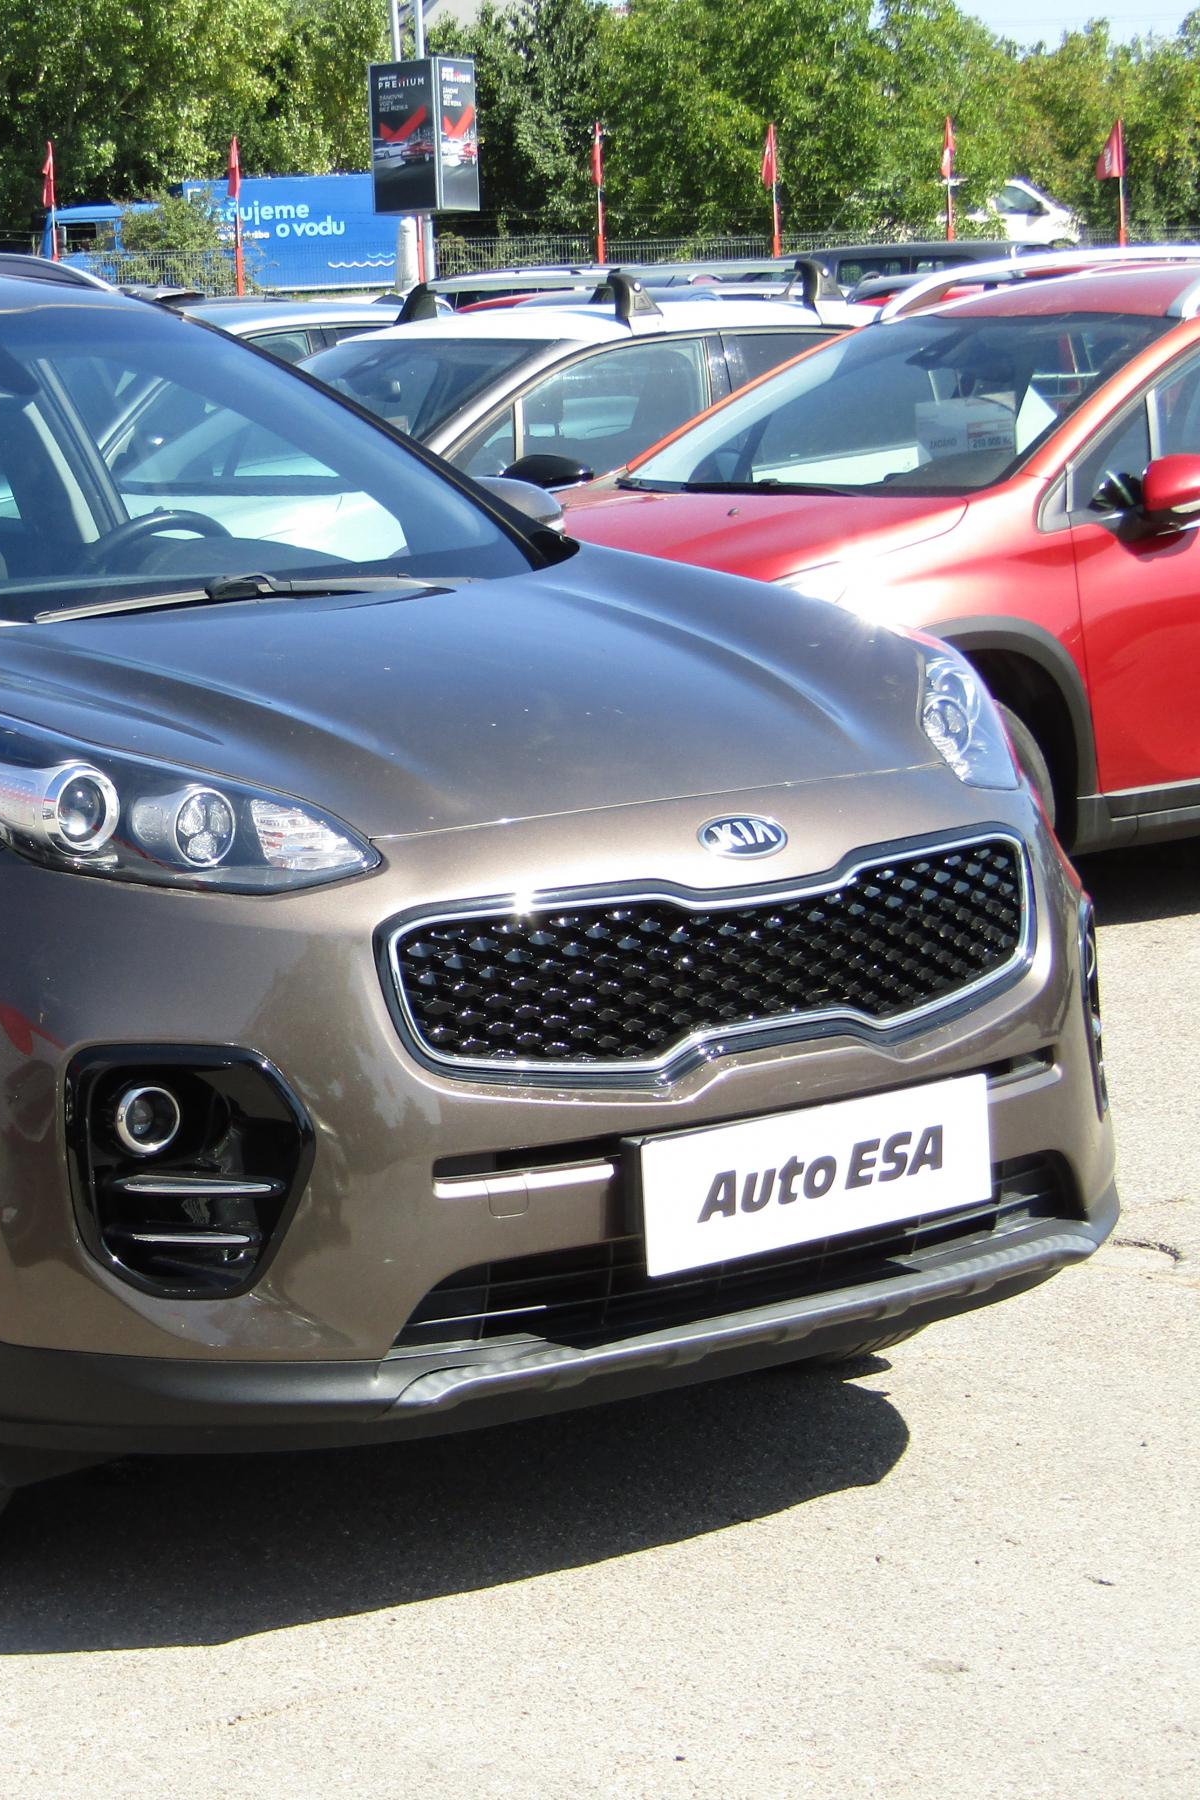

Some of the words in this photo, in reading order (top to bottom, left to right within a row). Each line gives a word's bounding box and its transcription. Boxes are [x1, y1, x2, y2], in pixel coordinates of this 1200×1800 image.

[275, 223, 290, 238] o
[292, 215, 345, 237] vodu
[709, 820, 778, 850] KIA
[698, 1155, 837, 1223] Auto
[845, 1124, 943, 1190] ESA
